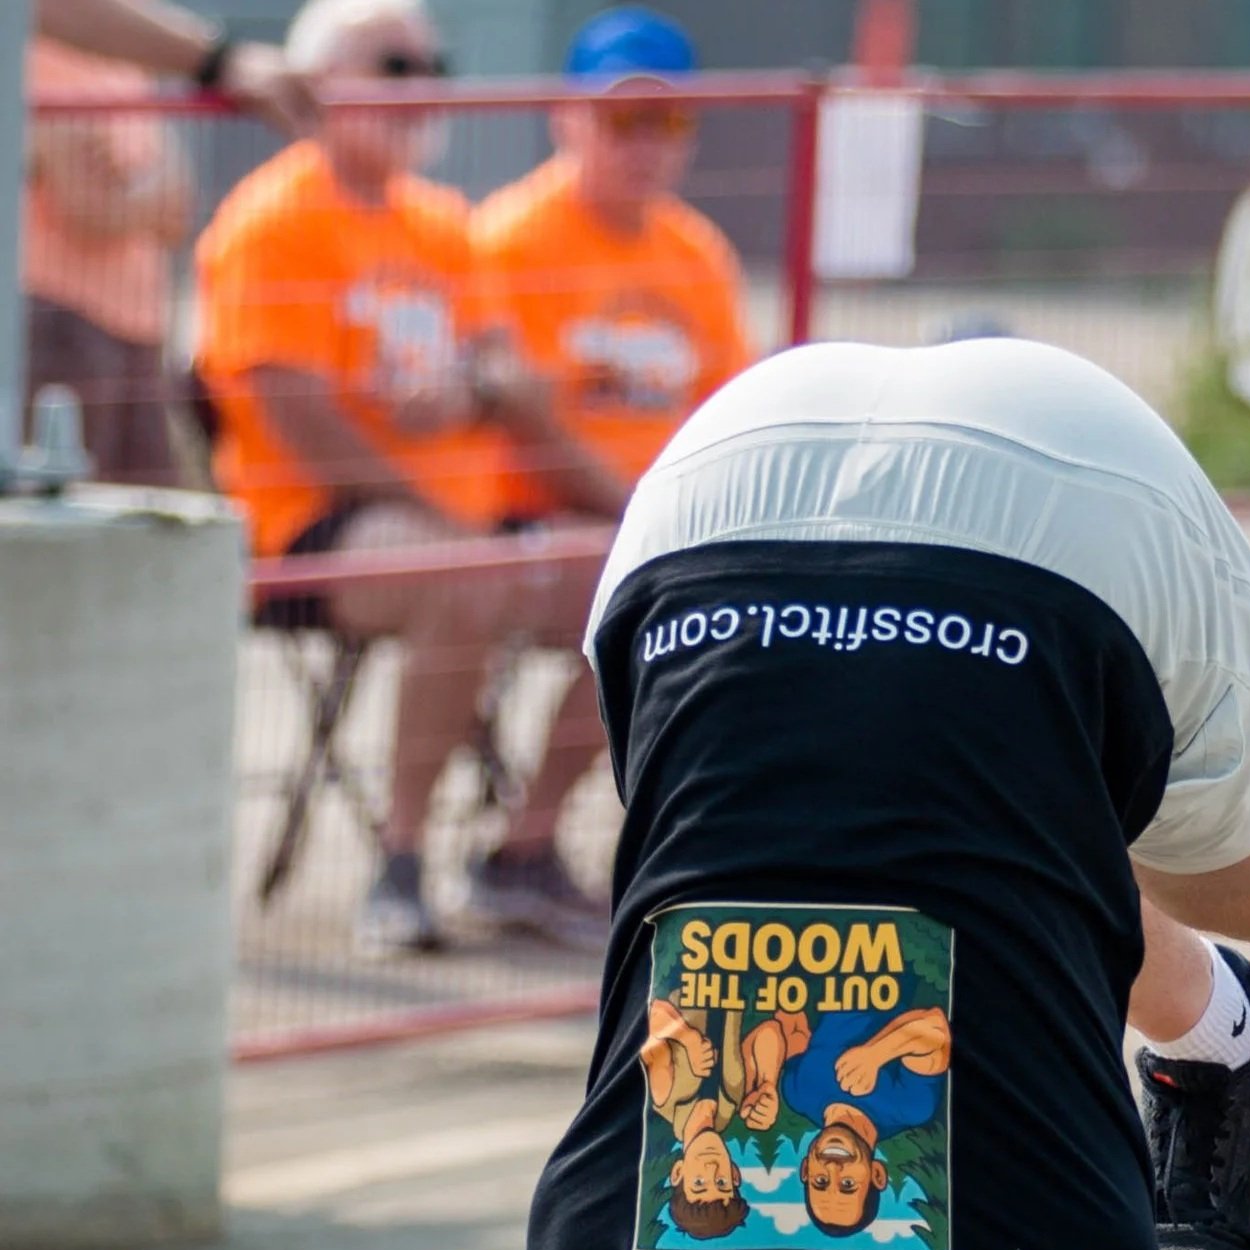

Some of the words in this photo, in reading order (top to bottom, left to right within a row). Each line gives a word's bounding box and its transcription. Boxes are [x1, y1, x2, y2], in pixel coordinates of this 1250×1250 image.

[641, 602, 1031, 667] crossfitcl.com
[680, 919, 905, 974] WOODS
[680, 972, 745, 1011] THE
[756, 975, 809, 1013] OF
[816, 974, 901, 1012] OUT
